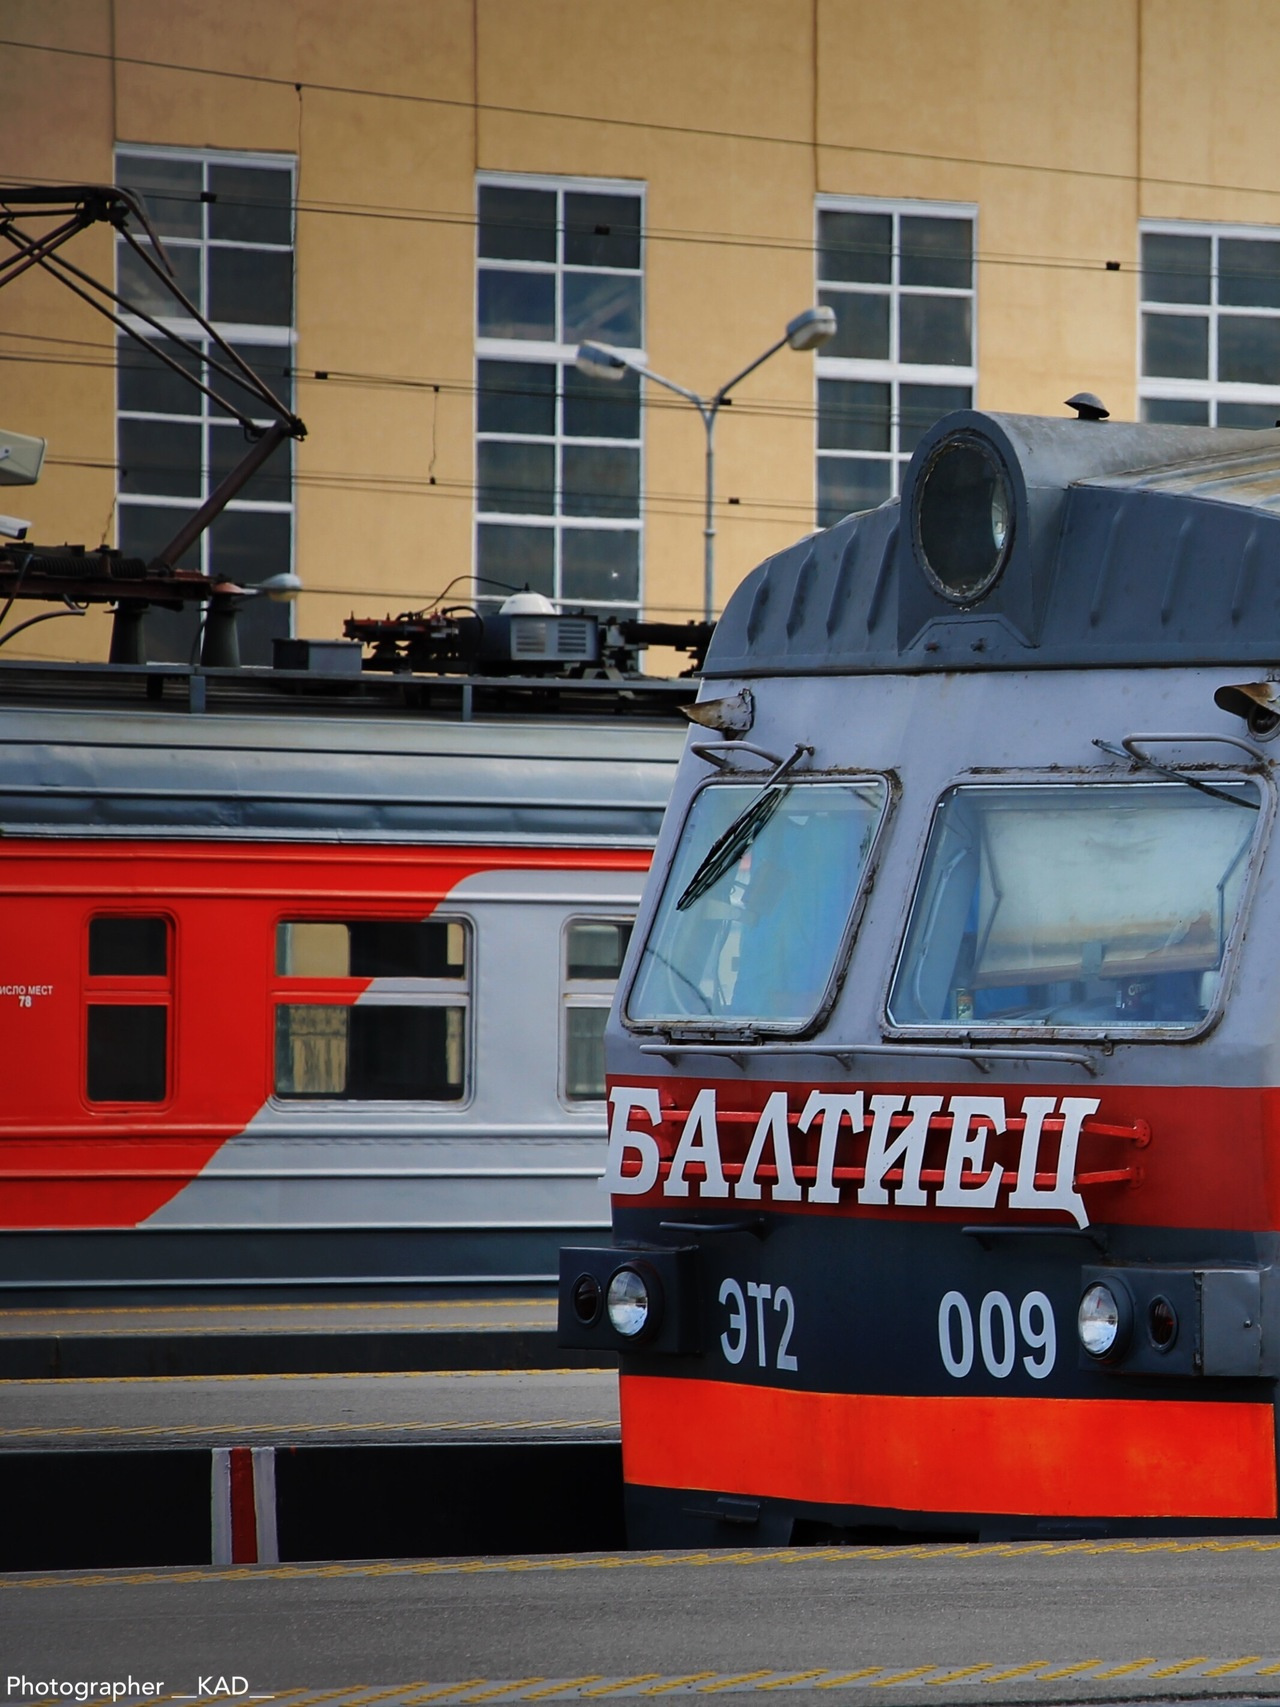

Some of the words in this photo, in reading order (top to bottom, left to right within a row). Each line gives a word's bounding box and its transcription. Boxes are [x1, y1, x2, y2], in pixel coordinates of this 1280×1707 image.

[18, 995, 32, 1008] 78
[27, 985, 53, 996] МЕСТ
[598, 1086, 1101, 1230] БАЛТИЕЦ
[718, 1277, 798, 1372] ЭТ2
[938, 1290, 1057, 1379] 009
